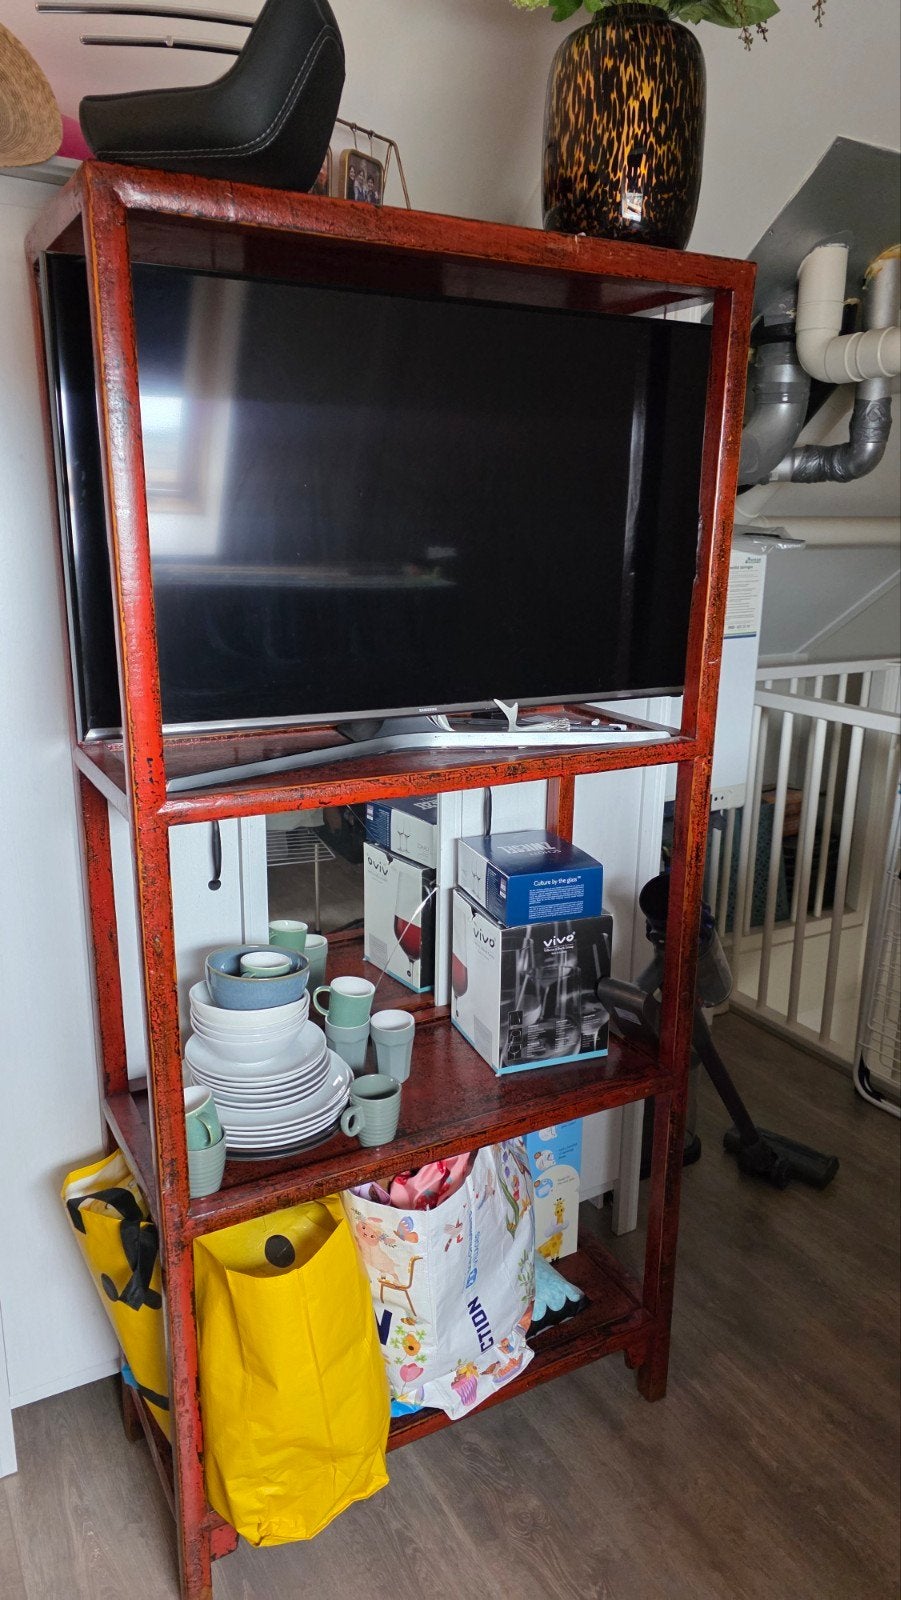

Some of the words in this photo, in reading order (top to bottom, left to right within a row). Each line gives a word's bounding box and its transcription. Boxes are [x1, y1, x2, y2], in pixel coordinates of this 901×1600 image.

[473, 928, 496, 948] vivo
[543, 932, 575, 947] vivo
[467, 1296, 495, 1353] CTION
